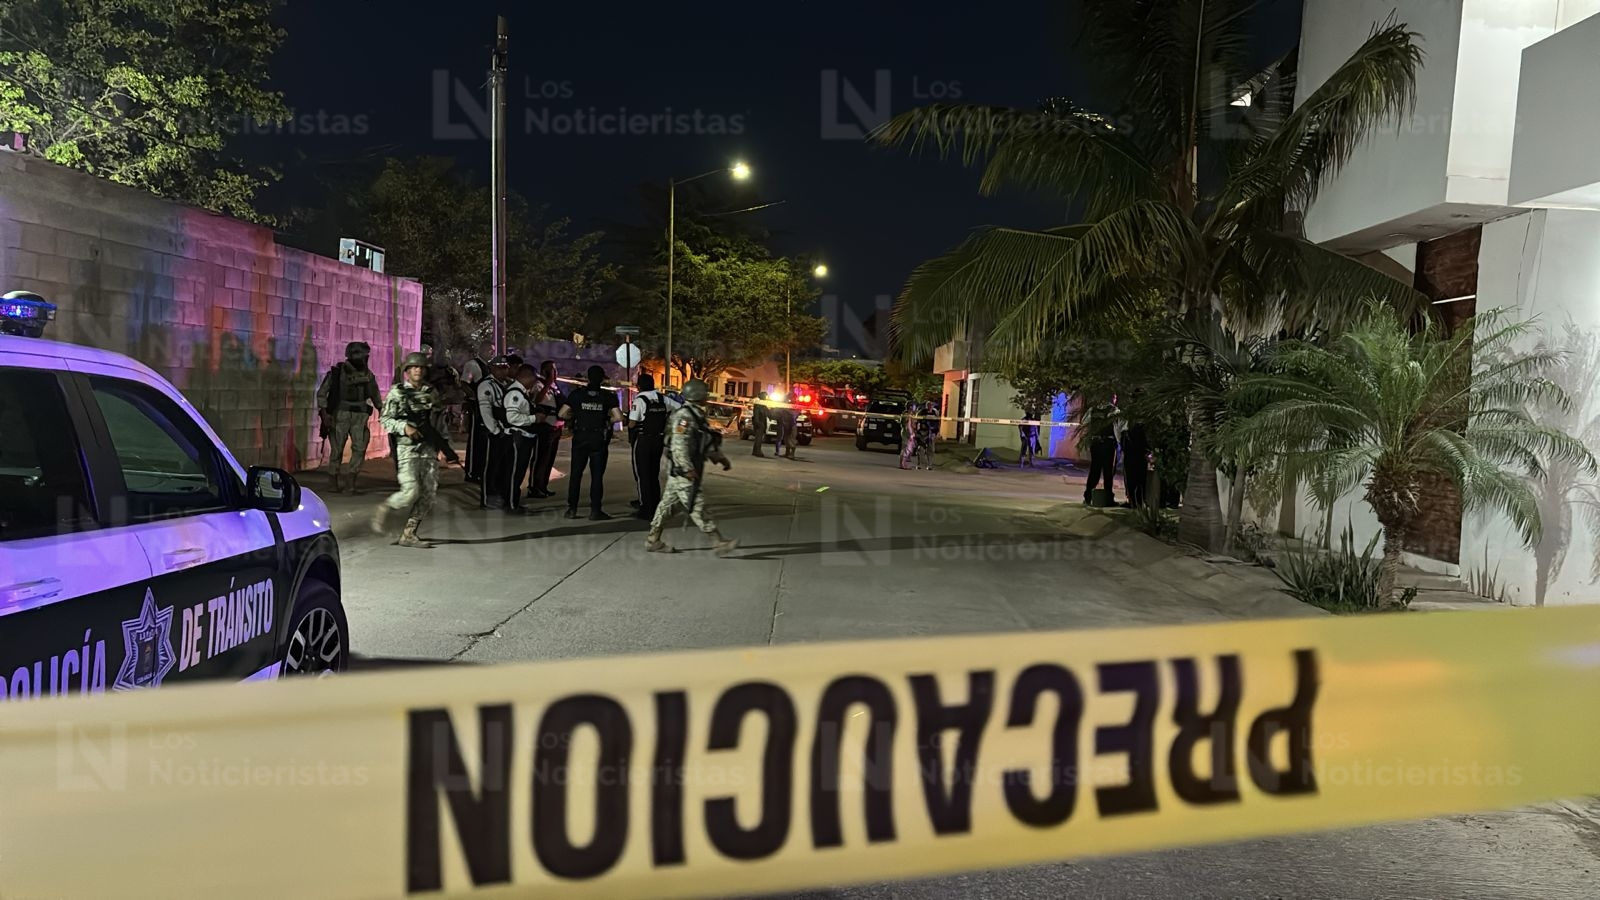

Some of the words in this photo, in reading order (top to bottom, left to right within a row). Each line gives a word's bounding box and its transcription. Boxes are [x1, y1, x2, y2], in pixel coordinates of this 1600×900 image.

[0, 628, 105, 694] OLICÍA
[178, 606, 203, 672] DE
[207, 576, 274, 660] TRÁNSITO
[406, 647, 1320, 893] PRECAUCION
